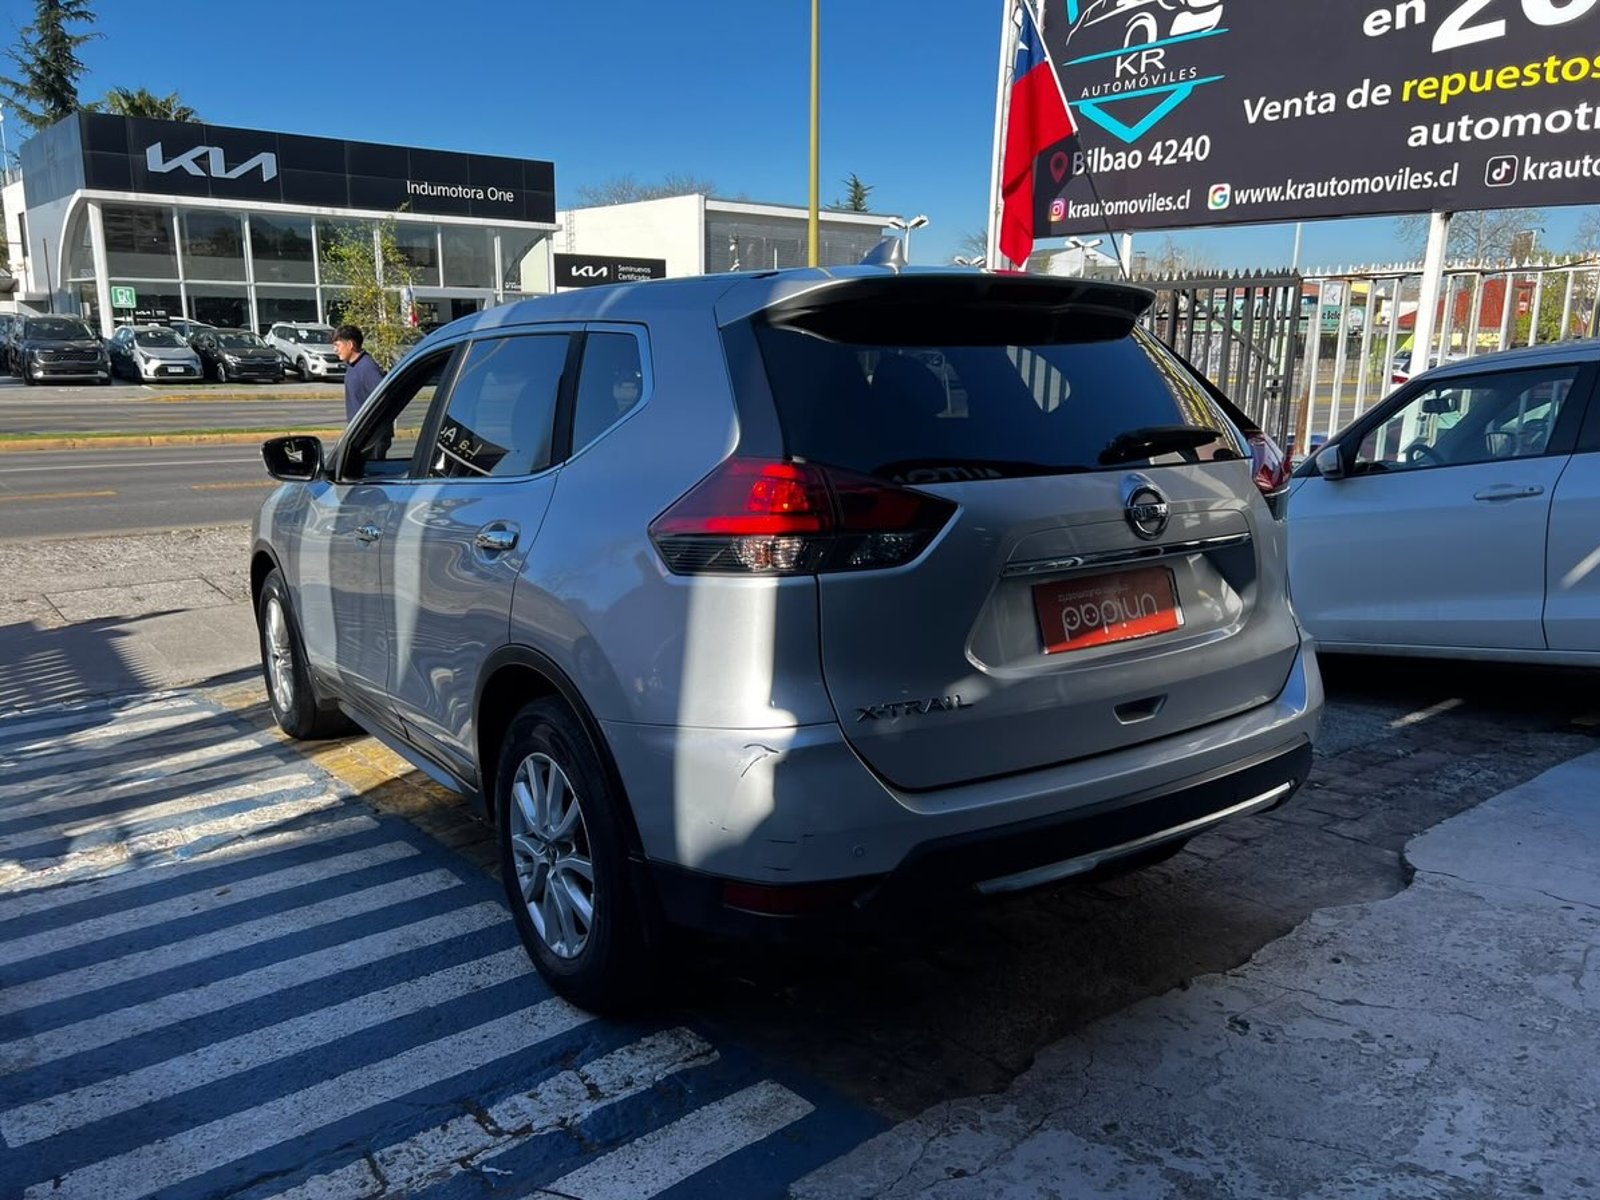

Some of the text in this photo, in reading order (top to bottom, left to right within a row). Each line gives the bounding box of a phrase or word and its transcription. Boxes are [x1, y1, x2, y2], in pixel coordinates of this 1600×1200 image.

[1363, 0, 1426, 37] en
[1080, 66, 1197, 98] AUTOMÓVILES
[1115, 48, 1166, 78] KR
[1243, 90, 1337, 124] Venta
[1346, 78, 1392, 109] de
[146, 141, 278, 182] KIA
[1072, 135, 1211, 175] Bilbao 4240
[406, 180, 514, 202] Indumotora One
[1234, 162, 1459, 205] www.krautomoviles.cl
[1061, 593, 1158, 642] unidad
